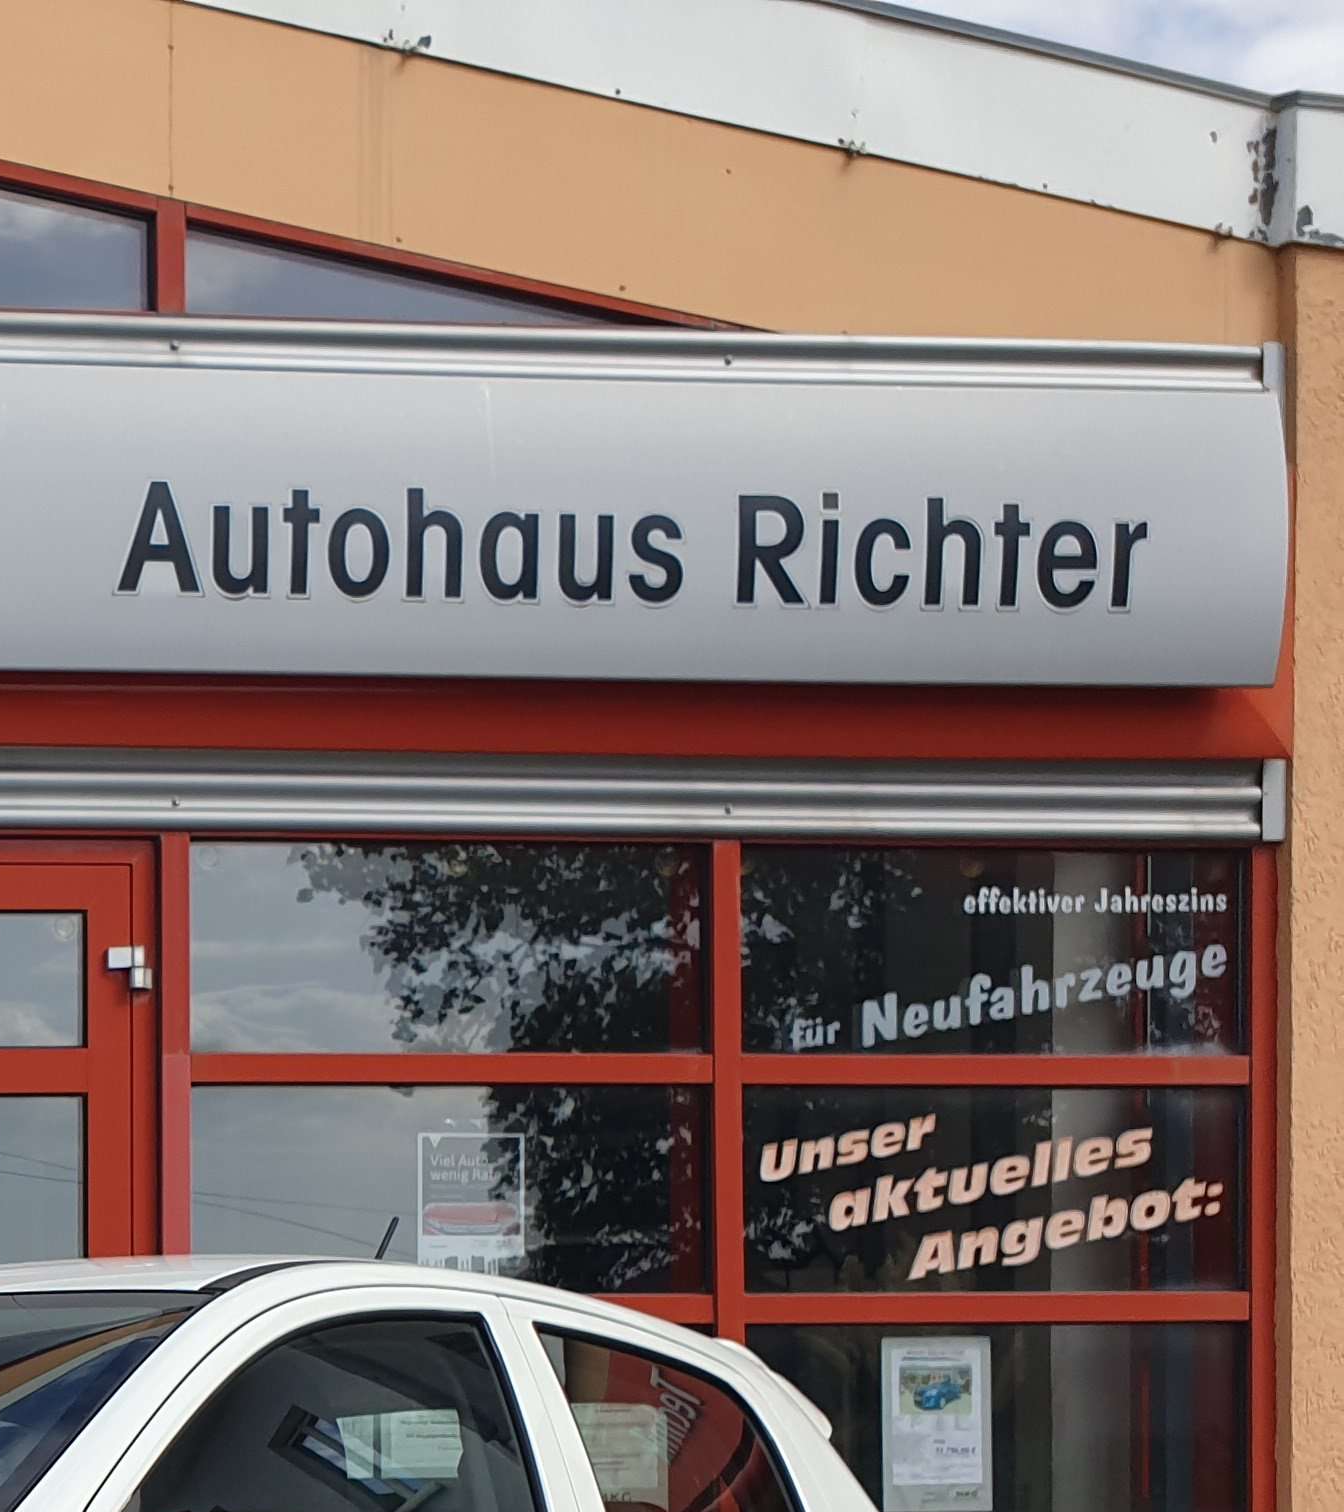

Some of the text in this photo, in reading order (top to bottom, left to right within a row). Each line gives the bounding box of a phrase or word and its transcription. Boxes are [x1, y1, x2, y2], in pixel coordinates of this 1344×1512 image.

[114, 480, 1150, 612] Autohaus Richter
[962, 886, 1228, 915] effektiver Jahreszins
[791, 943, 1227, 1052] für Neufahrzeuge
[759, 1113, 936, 1183] Unser
[829, 1127, 1153, 1233] aktuelles
[906, 1176, 1224, 1281] Angebot:
